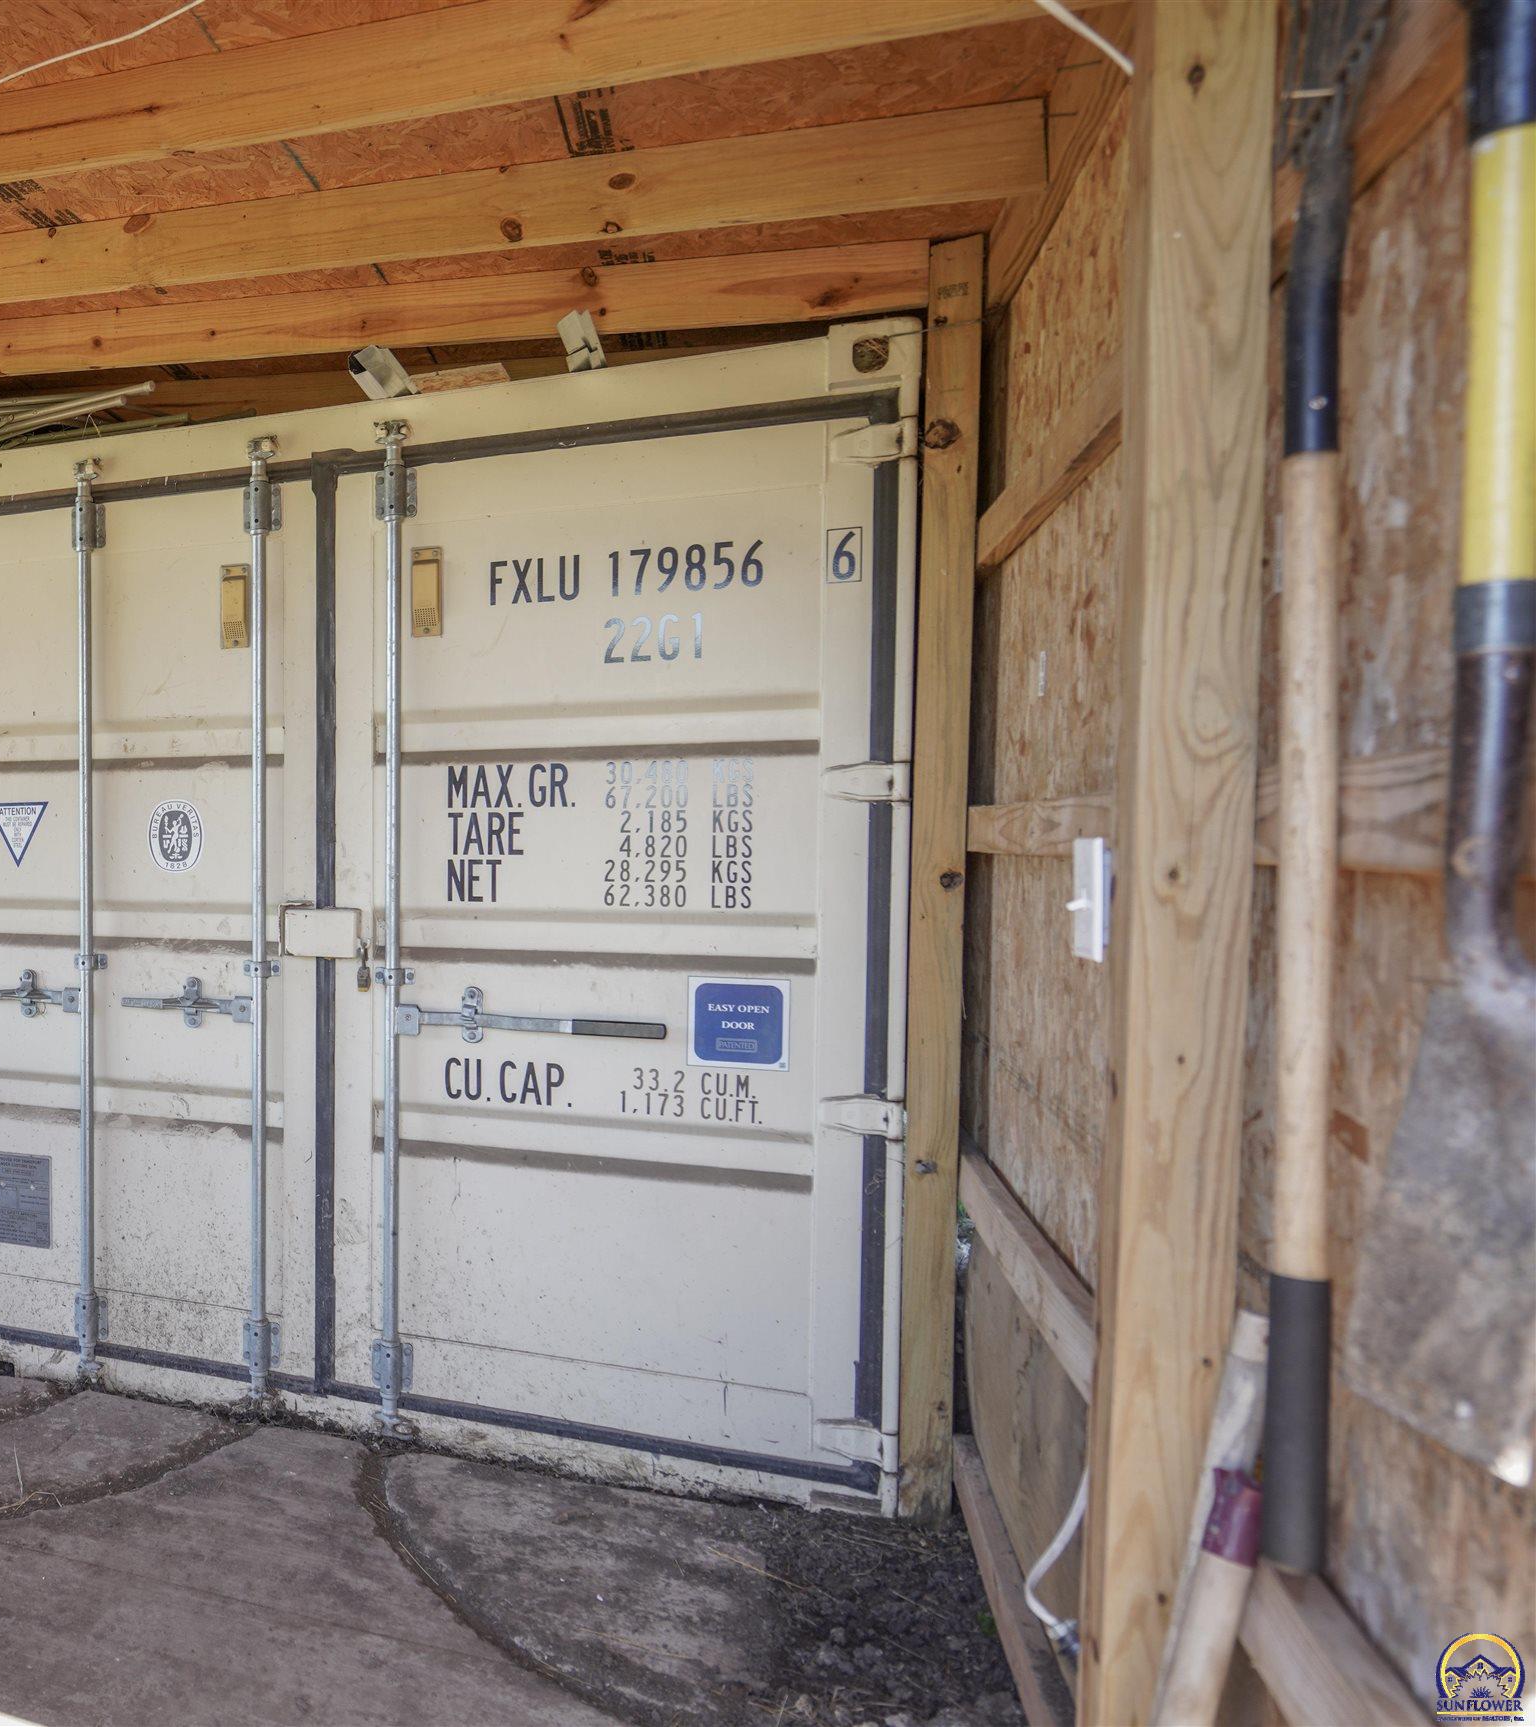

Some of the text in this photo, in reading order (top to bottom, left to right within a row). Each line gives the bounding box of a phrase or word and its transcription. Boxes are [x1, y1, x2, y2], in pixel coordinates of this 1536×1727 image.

[489, 530, 857, 606] FXLU 179856 6
[603, 612, 703, 664] 22G1
[605, 783, 754, 809] 67,200 LBS
[0, 807, 37, 816] ATTENTION
[152, 803, 200, 839] BUREAU VERITAS
[447, 810, 754, 856] TARE 2,185 KGS
[619, 834, 753, 859] 4,820 LBS
[165, 861, 188, 869] 1828
[446, 859, 752, 903] NET 28,295 KGS
[603, 884, 752, 909] 62,380 LBS
[707, 1003, 771, 1014] EASY OPEN
[721, 1020, 756, 1030] DOOR
[719, 1040, 755, 1050] PATENTED
[633, 1067, 685, 1095] 33.2
[619, 1090, 685, 1118] 1,173
